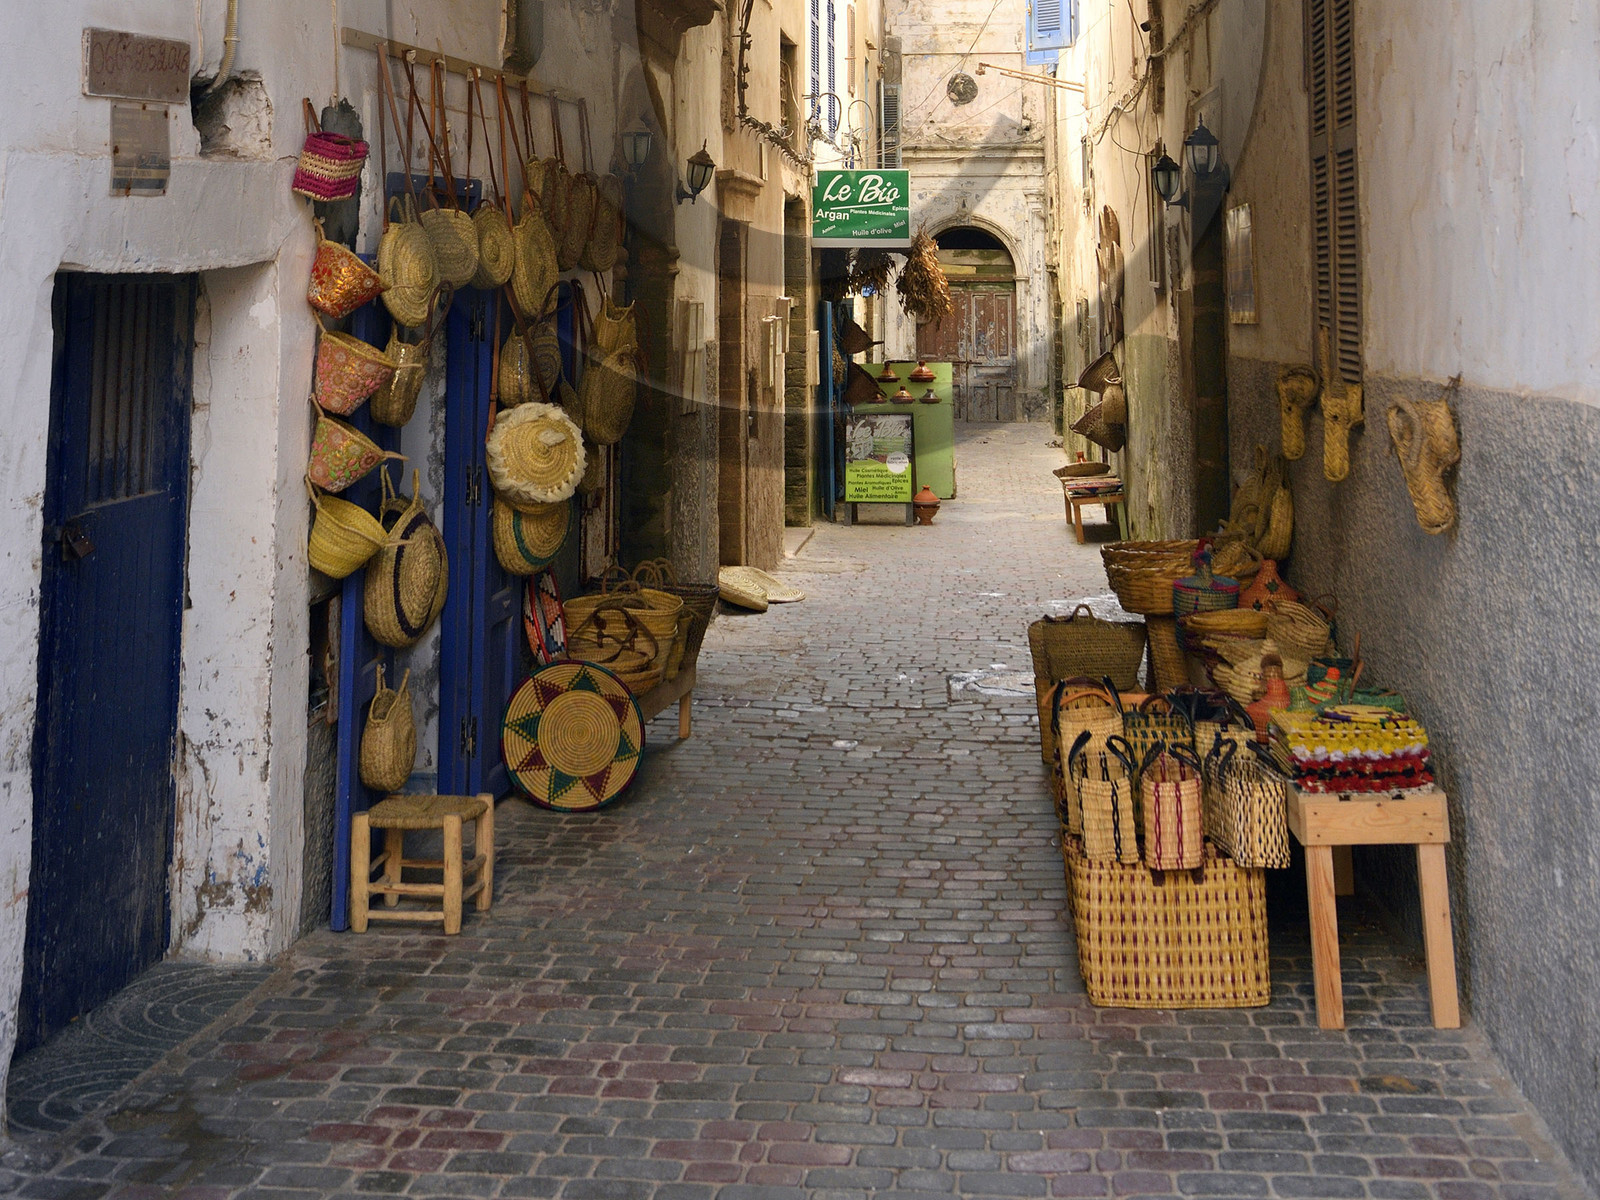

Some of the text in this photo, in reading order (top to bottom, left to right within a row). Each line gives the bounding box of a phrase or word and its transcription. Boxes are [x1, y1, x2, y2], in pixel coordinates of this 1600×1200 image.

[822, 174, 901, 203] Le Bio
[815, 208, 850, 222] Argan
[893, 220, 906, 229] Miel
[852, 227, 893, 237] Huile d'olive
